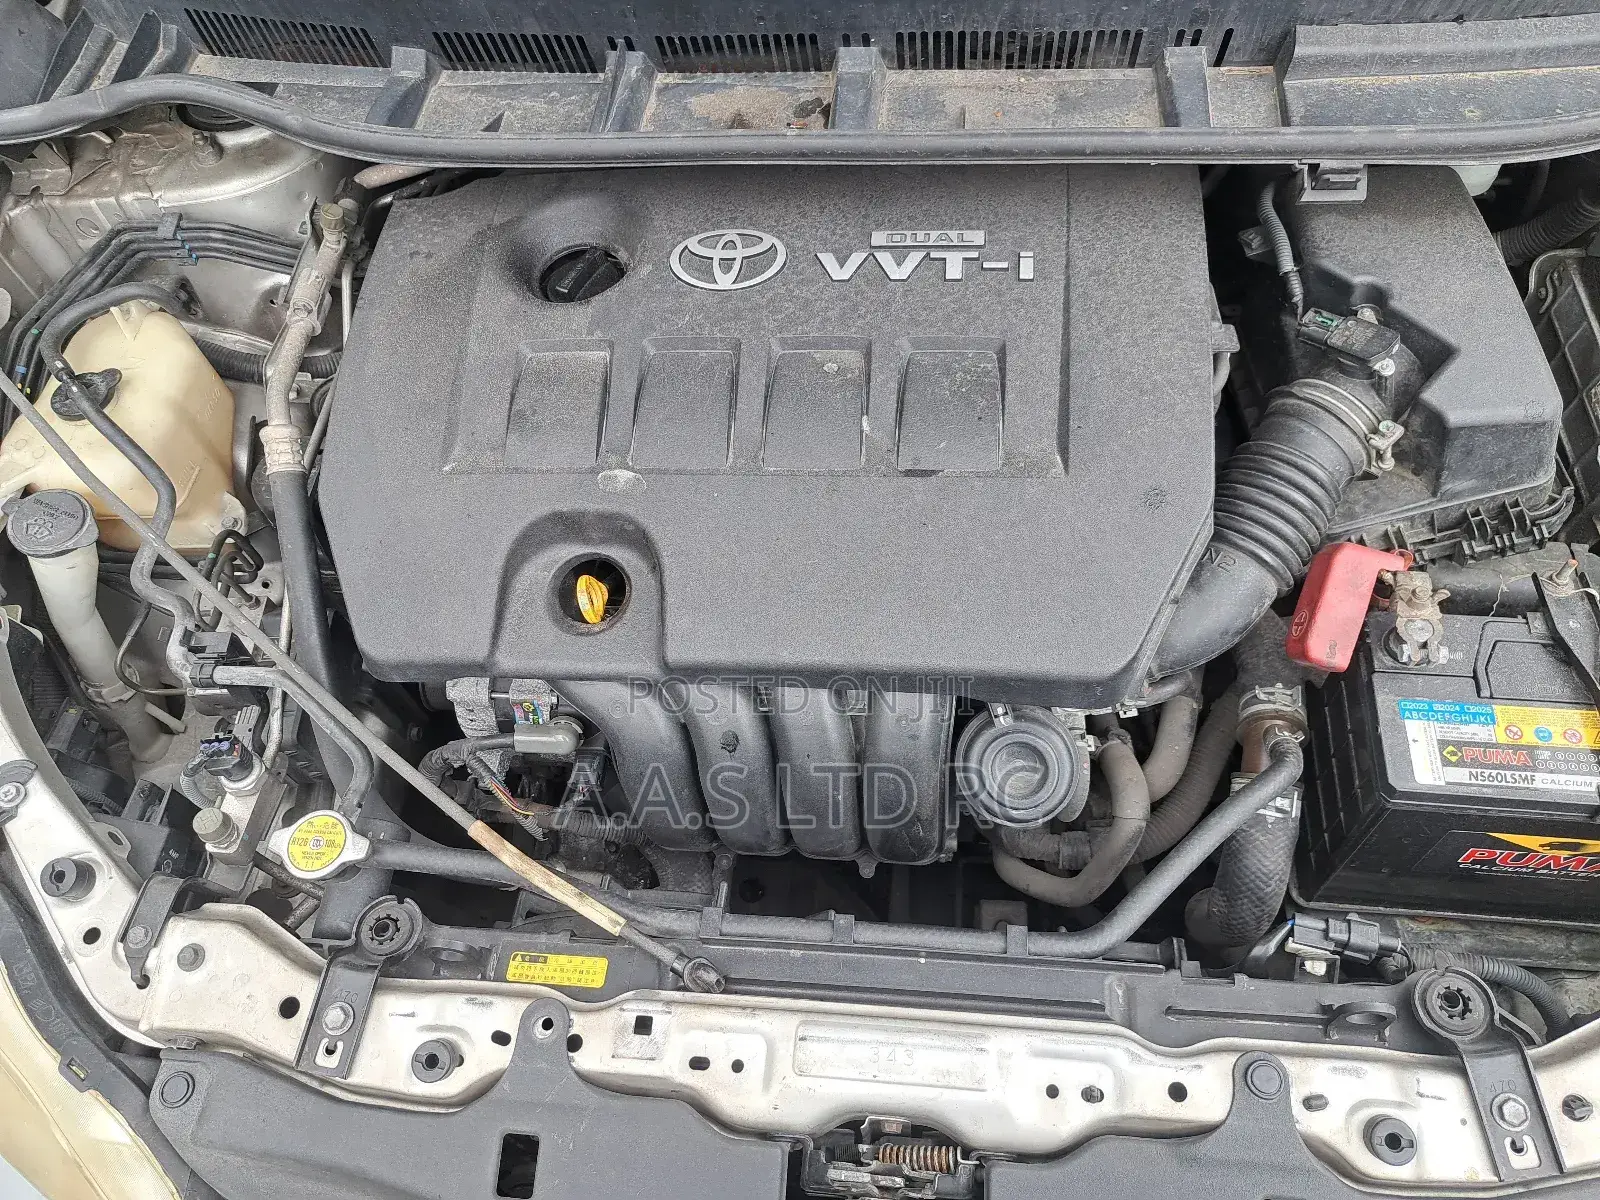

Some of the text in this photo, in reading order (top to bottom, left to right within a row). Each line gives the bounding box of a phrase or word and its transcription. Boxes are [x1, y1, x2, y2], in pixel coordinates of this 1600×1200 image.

[885, 232, 975, 244] DUAL
[814, 251, 1034, 281] VVT-i
[1471, 705, 1492, 713] 2025
[1462, 746, 1533, 767] PUMA
[1469, 771, 1593, 788] NS60LSMF CALCIUM
[1459, 863, 1534, 873] CALCIUM
